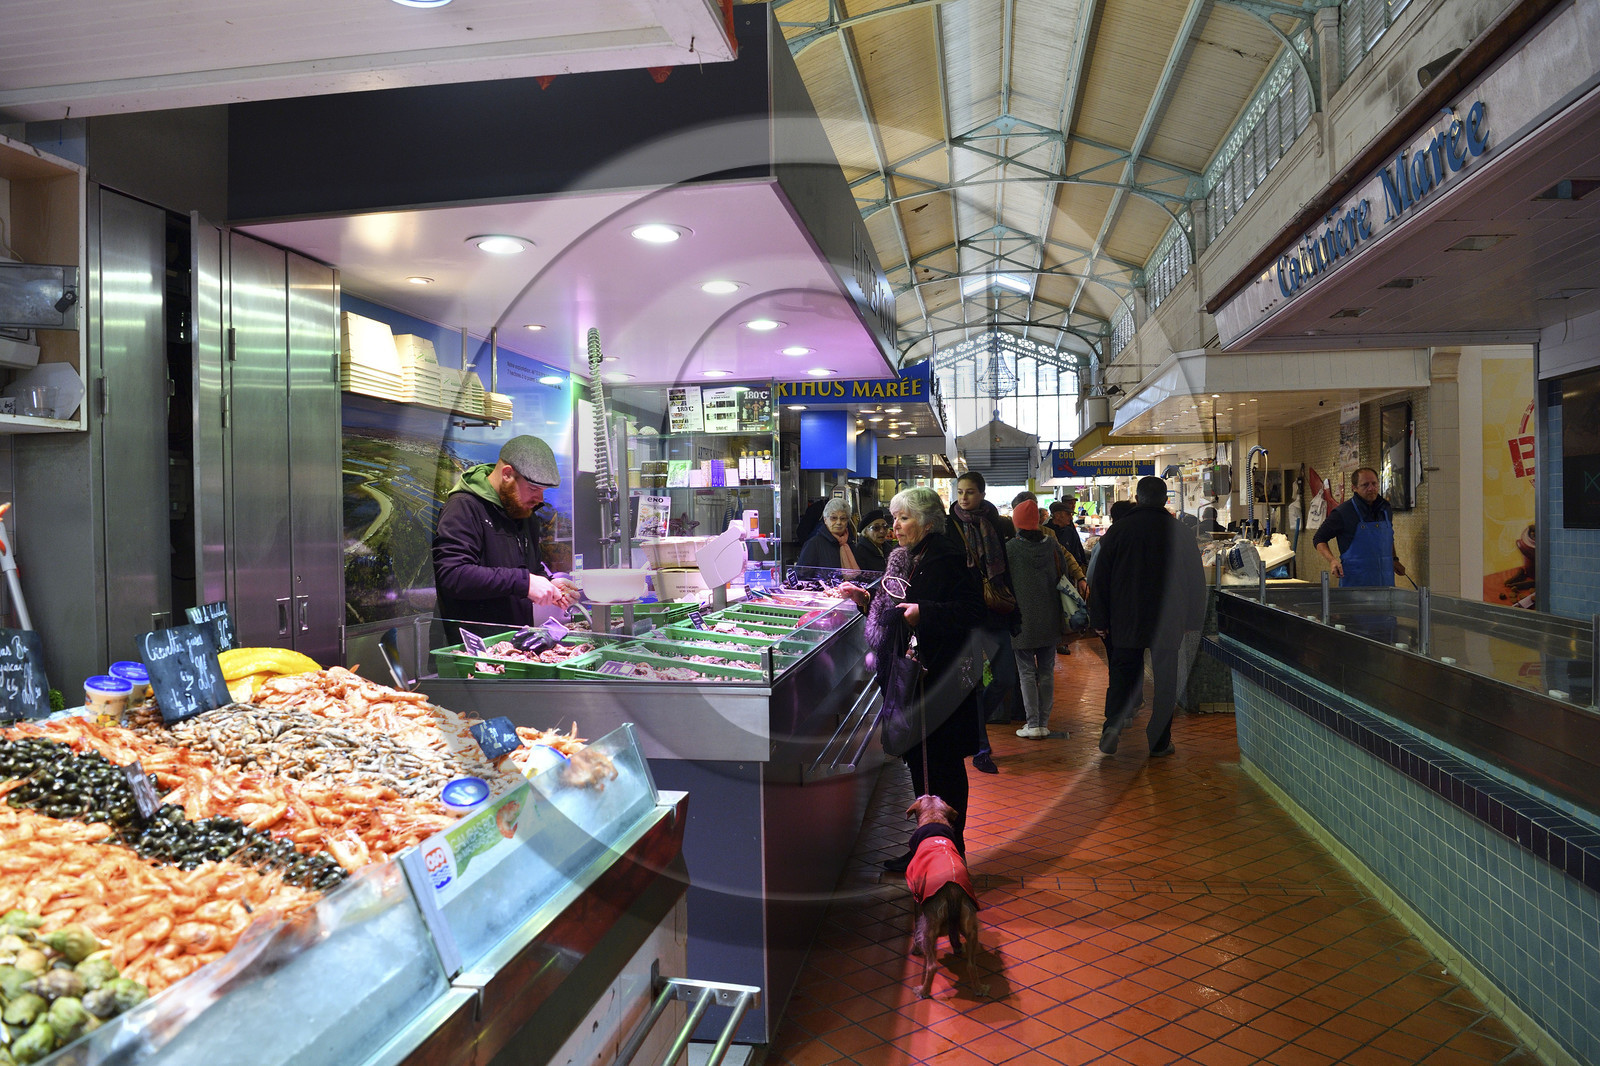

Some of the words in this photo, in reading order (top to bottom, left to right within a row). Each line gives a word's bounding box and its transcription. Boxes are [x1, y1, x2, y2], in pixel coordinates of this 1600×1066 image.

[771, 381, 845, 397] RTHUS
[852, 377, 922, 397] MARÉE
[1103, 467, 1139, 475] EMPORTER
